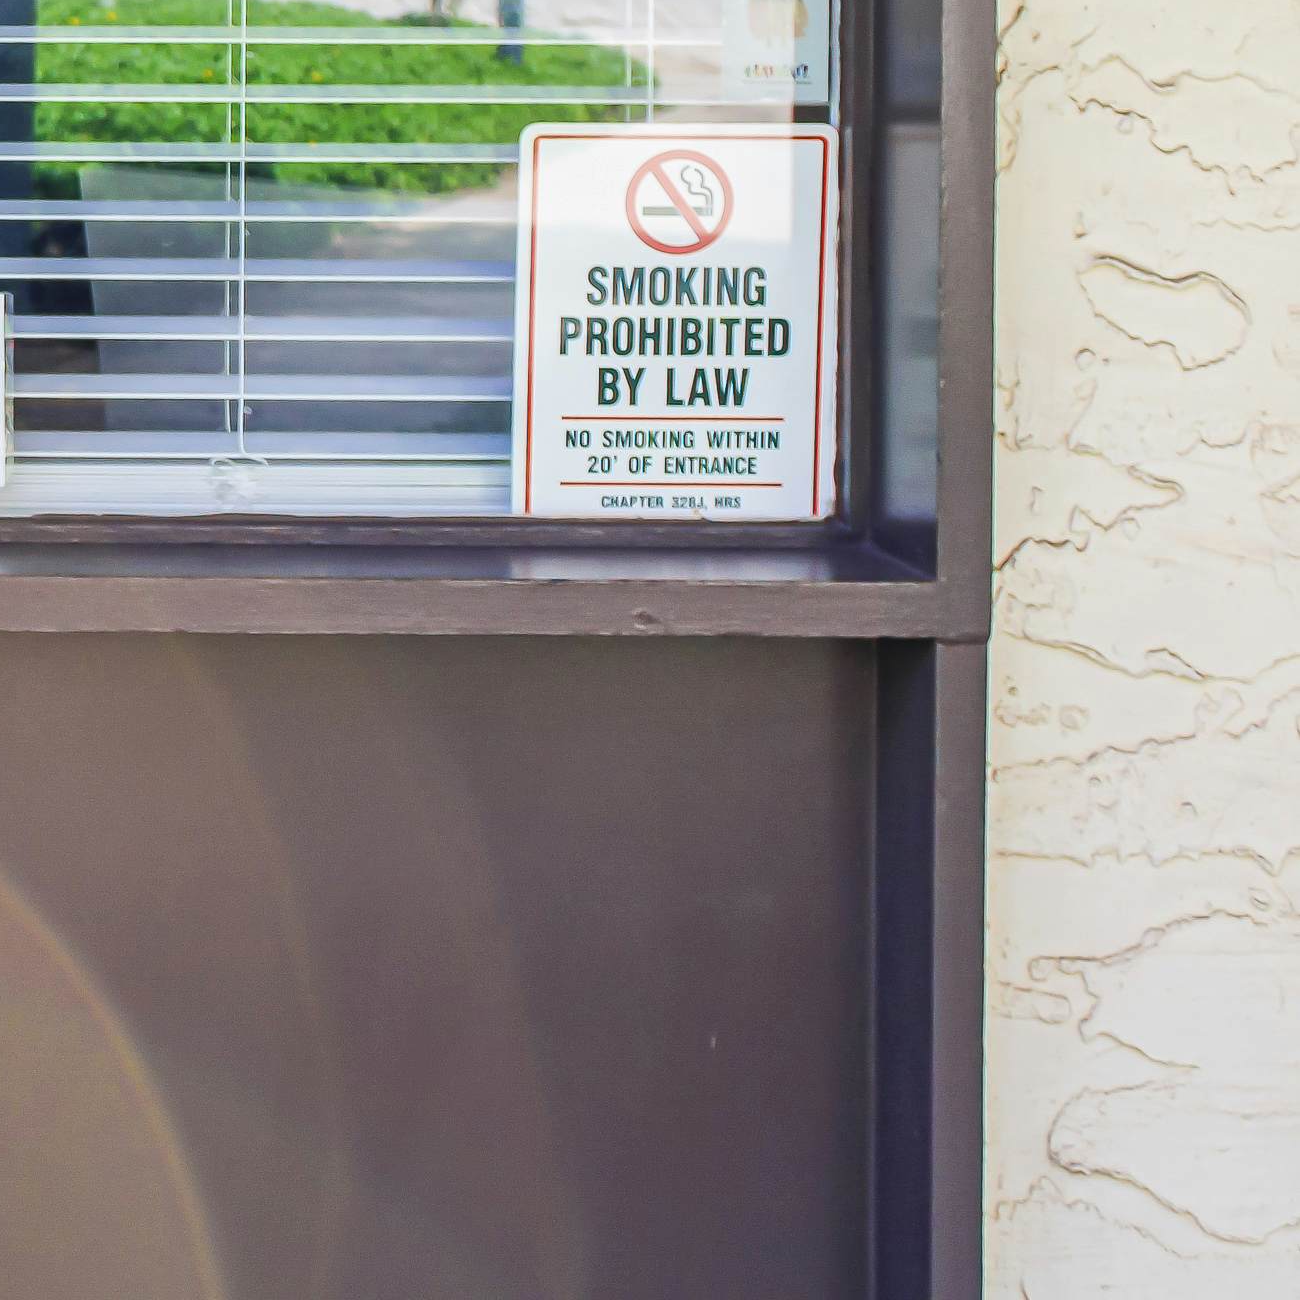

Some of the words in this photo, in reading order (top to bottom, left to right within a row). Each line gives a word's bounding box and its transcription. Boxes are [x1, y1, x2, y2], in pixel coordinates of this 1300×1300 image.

[586, 266, 766, 306] SMOKING
[559, 316, 791, 357] PROHIBITED
[597, 367, 646, 406] BY
[666, 367, 749, 407] LAW
[565, 430, 591, 448] NO
[602, 430, 695, 448] SMOKING
[706, 430, 781, 449] WITHIN
[587, 455, 618, 474] 20'
[628, 456, 652, 474] OF
[663, 456, 757, 475] ENTRANCE
[601, 496, 664, 509] CHAPTER
[714, 497, 741, 509] HRS
